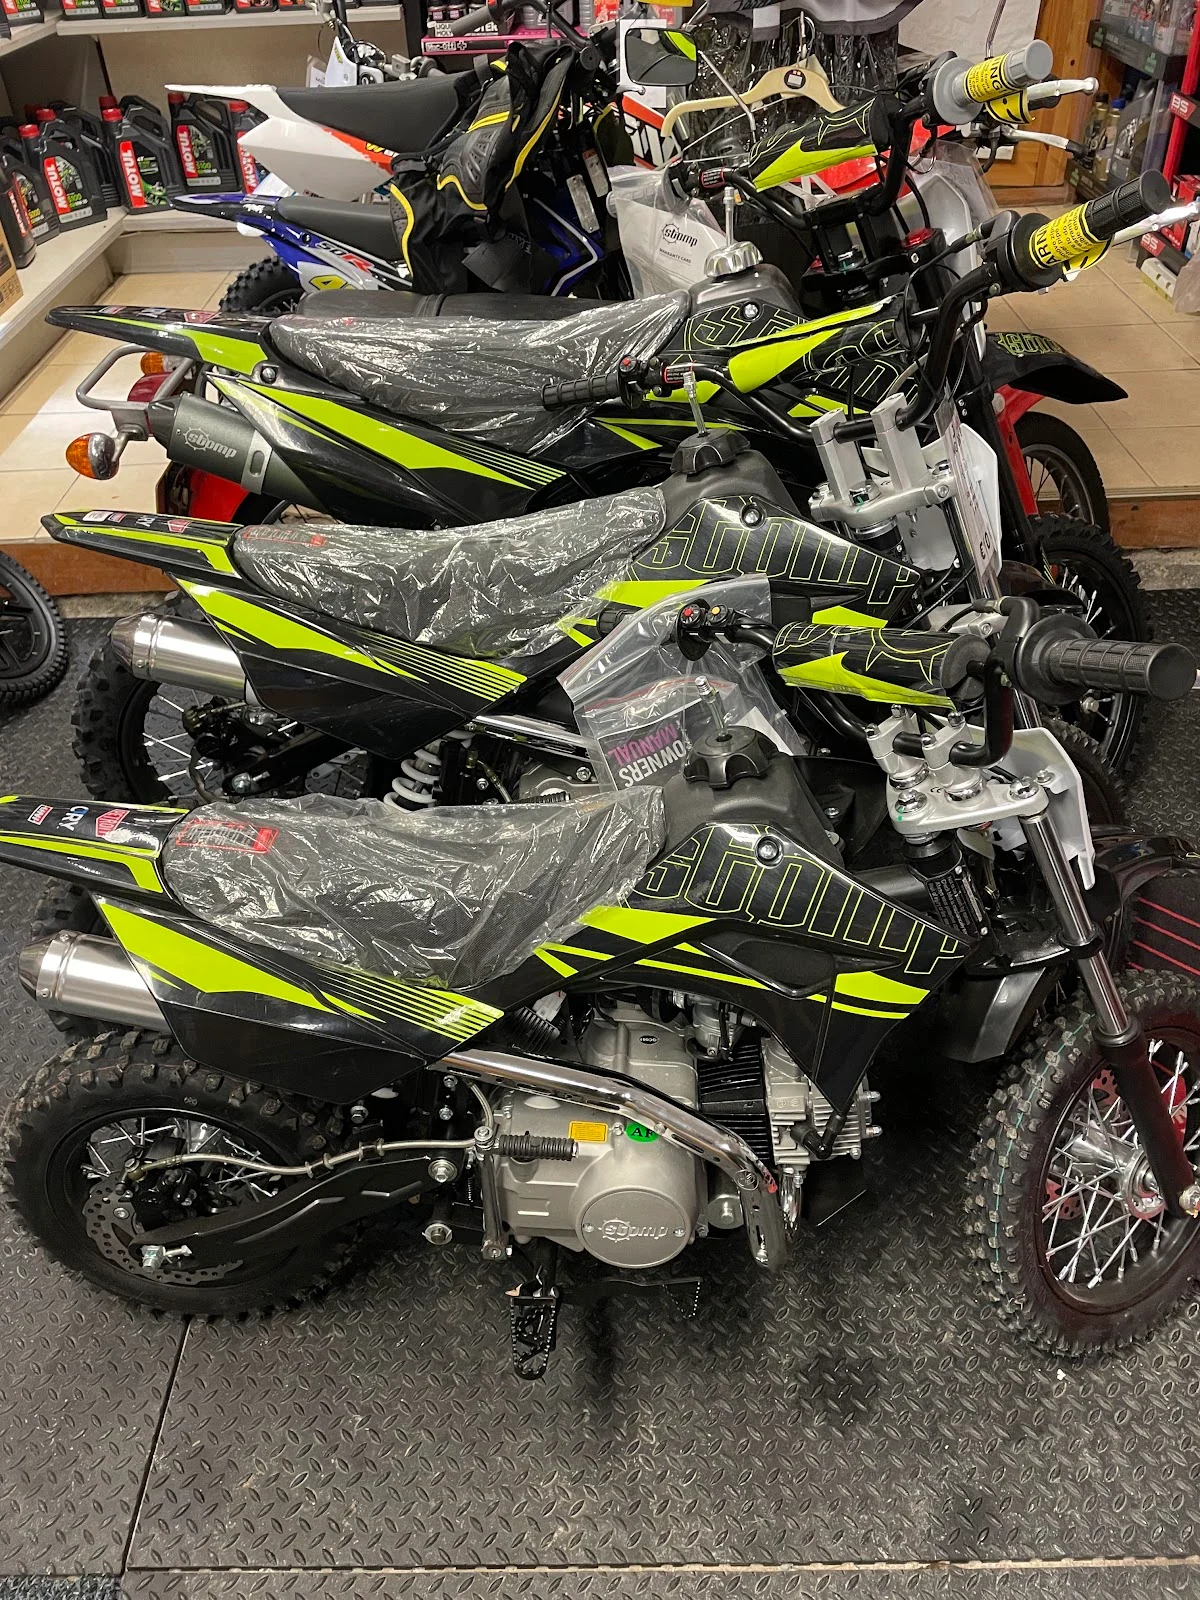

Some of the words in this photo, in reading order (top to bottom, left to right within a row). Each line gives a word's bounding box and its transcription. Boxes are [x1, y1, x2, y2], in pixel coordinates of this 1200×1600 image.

[1171, 94, 1189, 113] BS
[178, 131, 196, 174] MOTUL
[46, 163, 69, 209] MOTUL
[121, 149, 143, 197] MOTUL
[660, 248, 680, 259] WARRANTY
[663, 227, 698, 247] stomp
[187, 432, 238, 459] stomp
[608, 722, 679, 765] MANUAL
[618, 739, 688, 789] OWNERS
[603, 1222, 669, 1240] stomp
